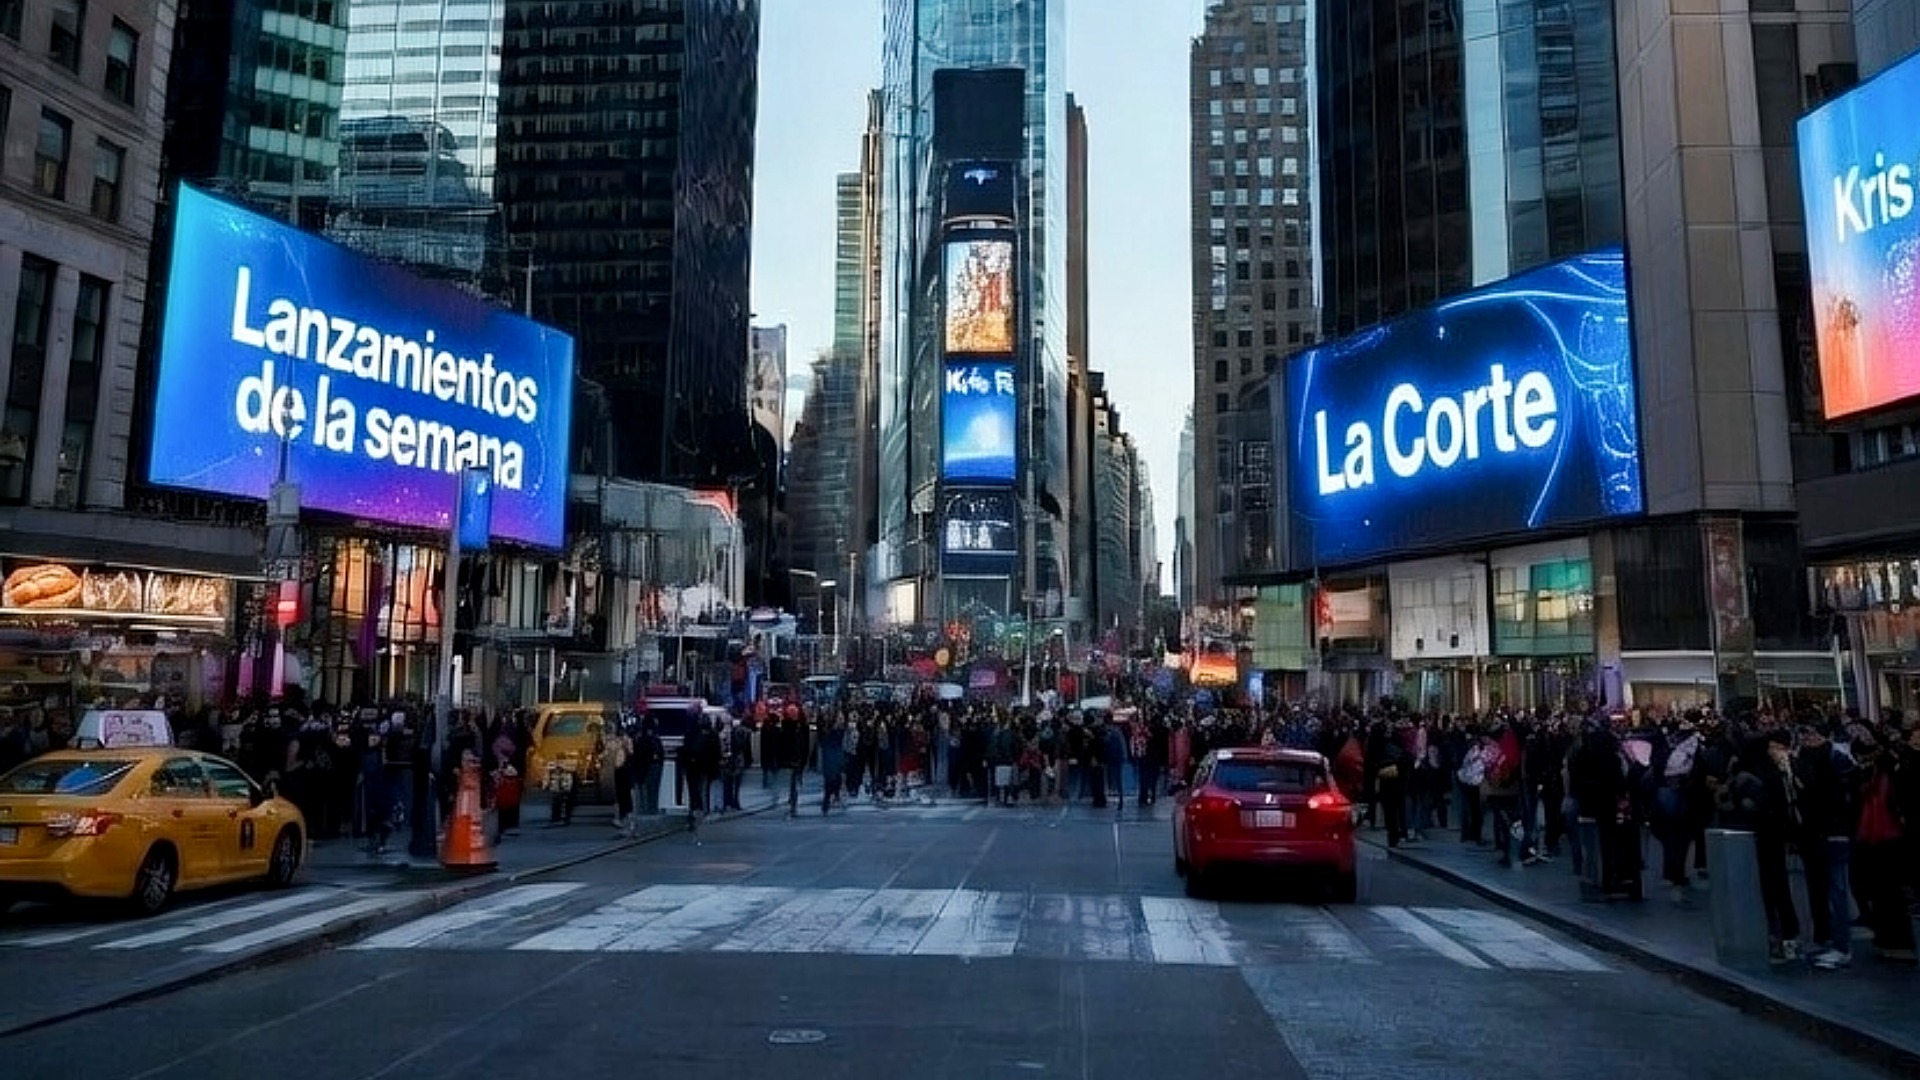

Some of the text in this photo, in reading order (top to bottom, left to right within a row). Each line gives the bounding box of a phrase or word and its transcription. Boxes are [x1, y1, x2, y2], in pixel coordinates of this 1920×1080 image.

[1834, 151, 1914, 243] Kris
[232, 266, 538, 423] Lanzamientos
[236, 360, 524, 490] de la semana
[1315, 363, 1557, 496] La Corte
